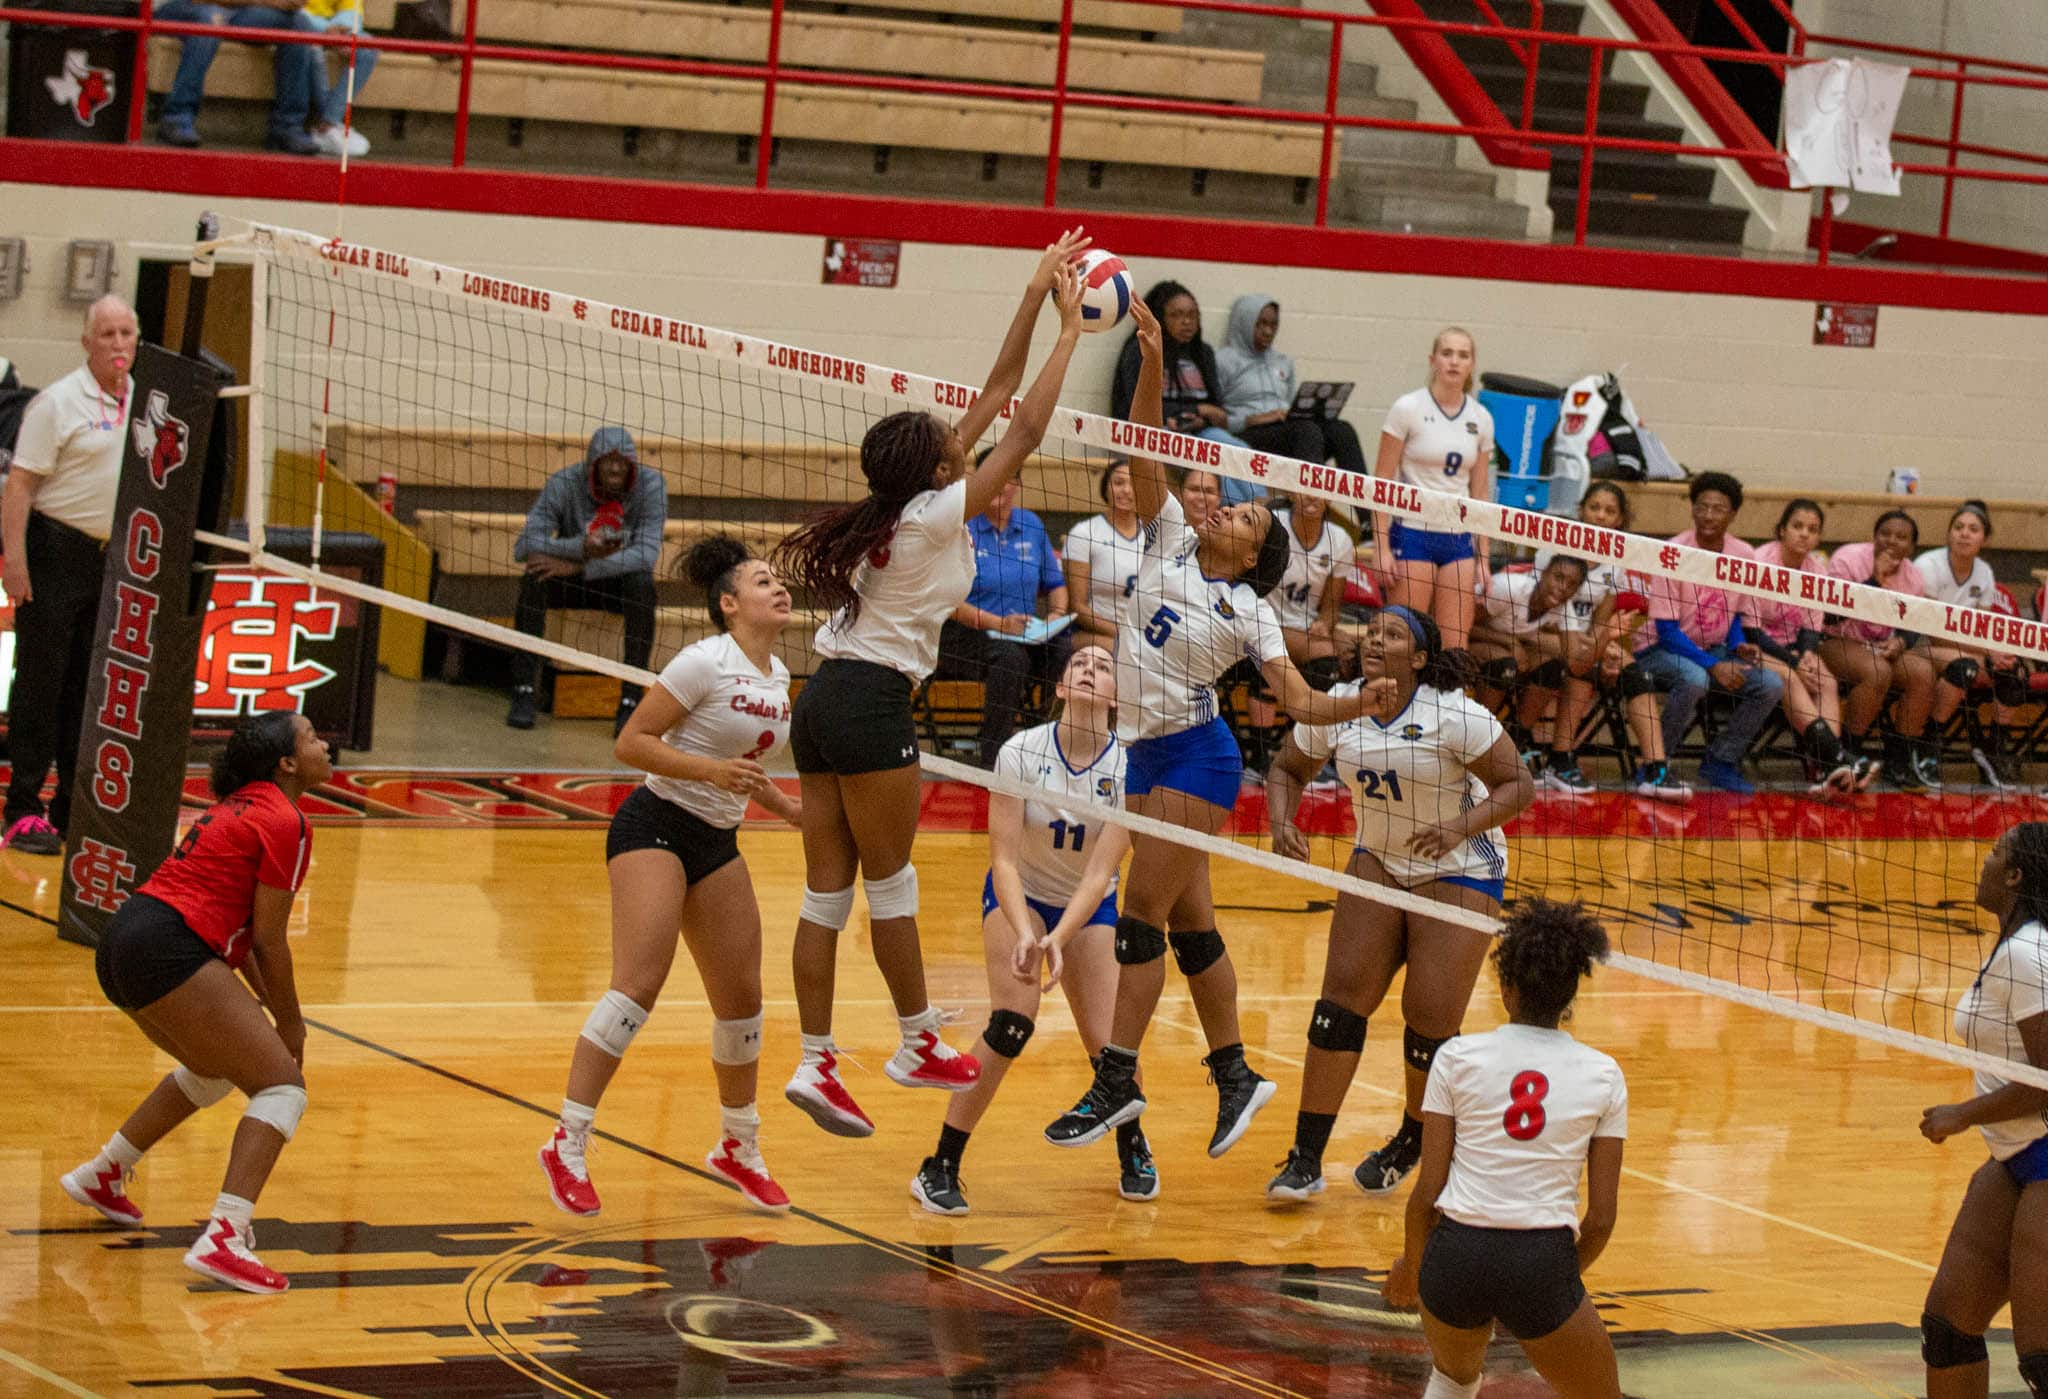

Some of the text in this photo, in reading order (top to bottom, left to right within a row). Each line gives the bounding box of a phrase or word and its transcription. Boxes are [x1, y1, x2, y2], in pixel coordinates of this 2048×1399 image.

[320, 243, 370, 268] CEDAR
[375, 252, 409, 277] HILL
[463, 274, 550, 312] LONGHORNS
[611, 308, 663, 339] CEDAR
[668, 321, 707, 349] HILL
[767, 344, 866, 385] LONGHORNS
[1443, 451, 1464, 477] 9
[1111, 421, 1221, 466] LONGHORNS
[1299, 463, 1365, 500] CEDAR
[1372, 480, 1422, 513] HILL
[1500, 508, 1625, 559] LONGHORNS
[1715, 557, 1790, 595] CEDAR
[1800, 575, 1855, 609] HILL
[1144, 604, 1182, 649] 5
[730, 694, 778, 720] Cedar
[742, 730, 776, 760] 2
[1356, 769, 1403, 802] 21
[1049, 818, 1086, 852] 11
[1502, 1069, 1550, 1142] 8
